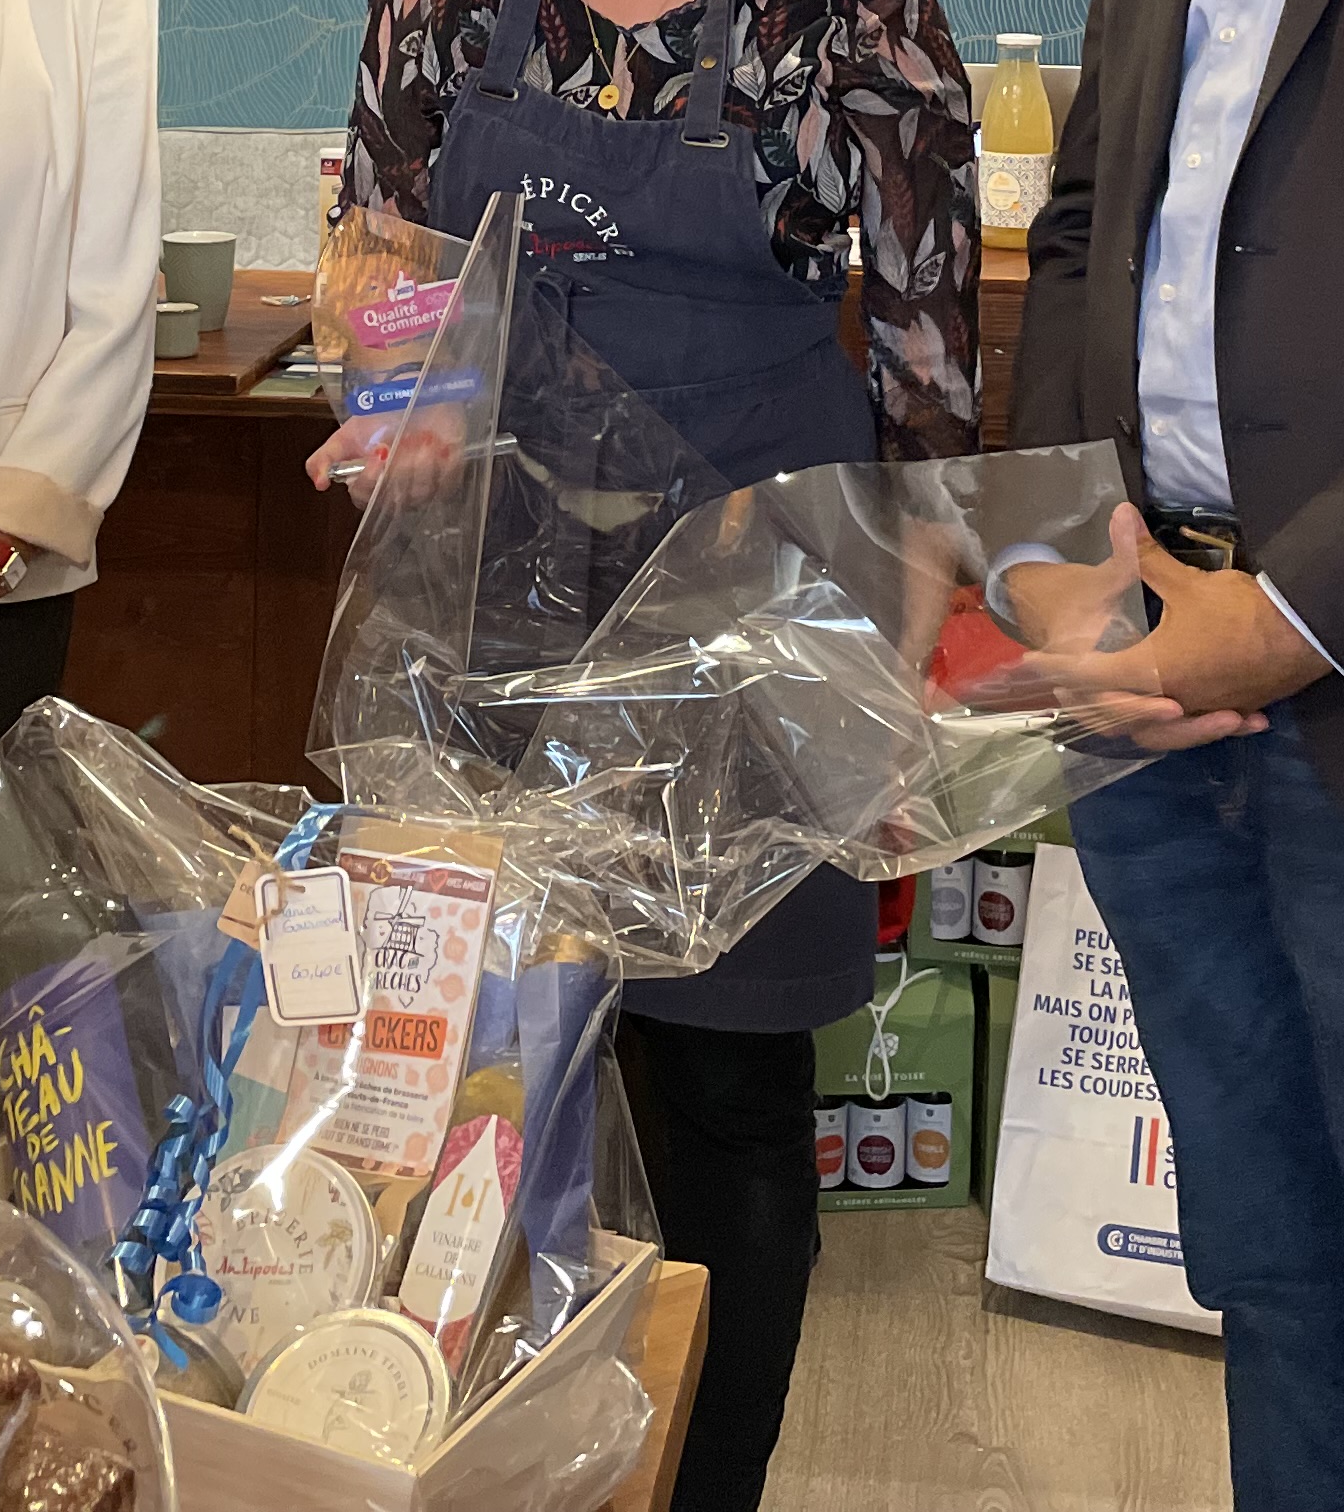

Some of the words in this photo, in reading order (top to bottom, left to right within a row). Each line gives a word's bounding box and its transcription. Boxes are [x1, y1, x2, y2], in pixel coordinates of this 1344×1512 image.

[363, 300, 418, 327] Qualité
[380, 309, 447, 335] commerc
[1075, 928, 1114, 952] PEU
[375, 950, 407, 969] CRAC
[1073, 952, 1096, 972] SE
[1100, 957, 1125, 977] SE
[372, 971, 422, 993] RECHES
[1090, 979, 1113, 1000] LA
[1119, 984, 1130, 1001] M
[1033, 993, 1083, 1018] MAIS
[1088, 1003, 1117, 1025] ON
[1123, 1009, 1134, 1025] P
[326, 1016, 441, 1053] CCKERS
[1068, 1023, 1142, 1051] TOUJOU
[1061, 1047, 1086, 1068] SE
[1091, 1052, 1151, 1076] SERRE
[1038, 1067, 1074, 1090] LES
[3, 1048, 84, 1144] TEAU
[27, 1122, 60, 1164] DE
[1165, 1145, 1175, 1163] S
[13, 1121, 118, 1217] RANNE
[1128, 1243, 1138, 1253] ET
[216, 1255, 295, 1280] Antipodes
[308, 1346, 380, 1371] DOMAINE
